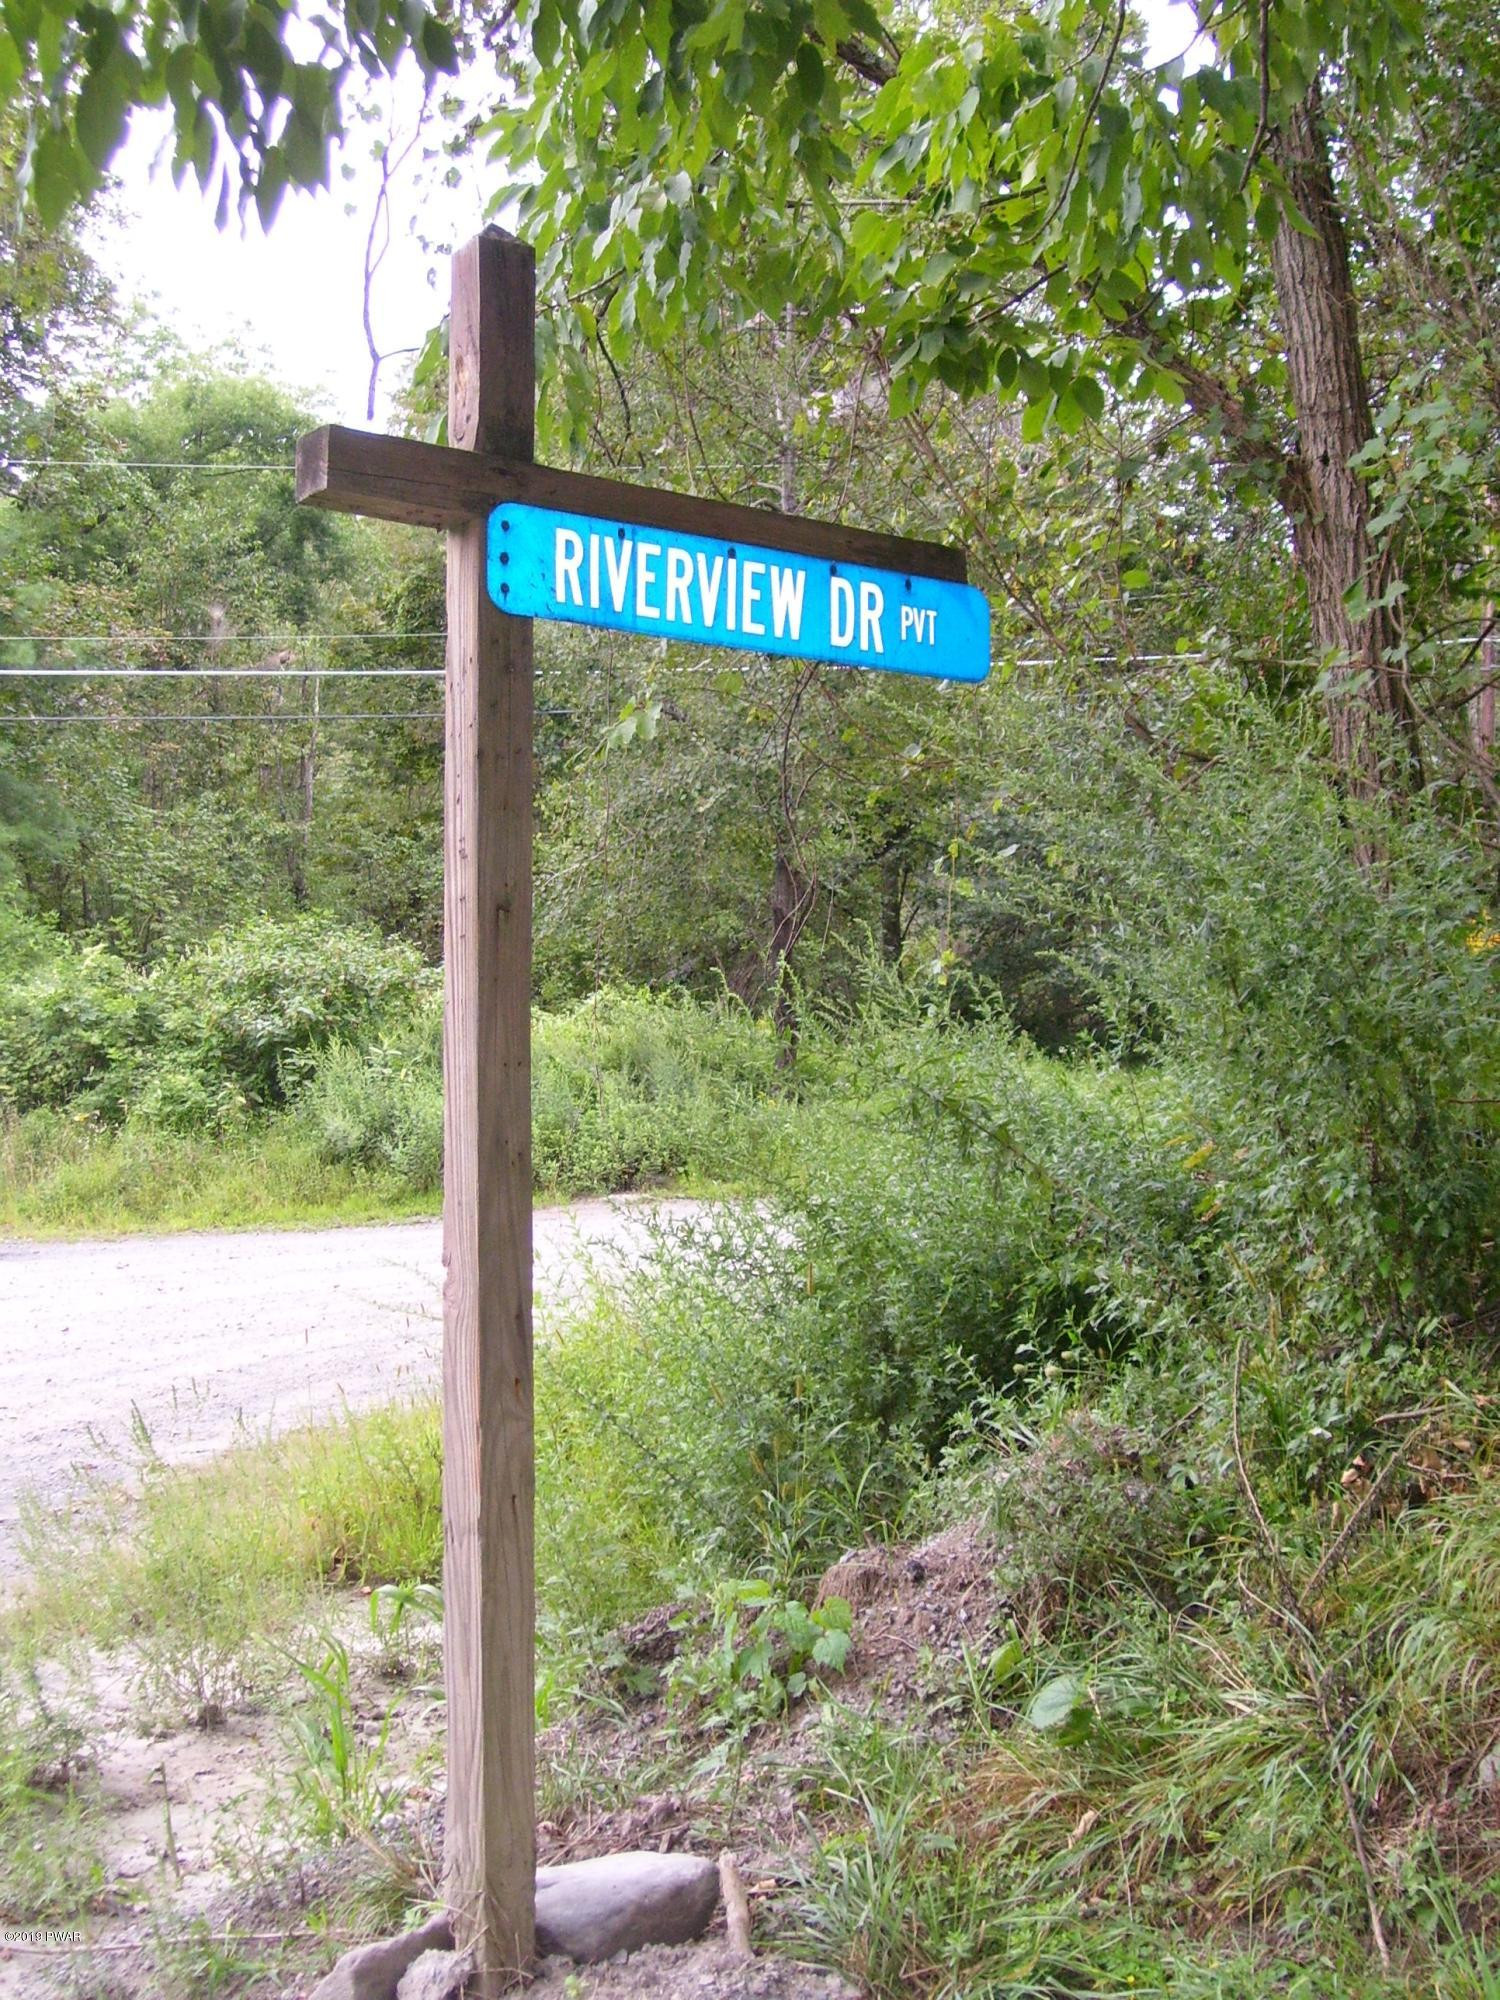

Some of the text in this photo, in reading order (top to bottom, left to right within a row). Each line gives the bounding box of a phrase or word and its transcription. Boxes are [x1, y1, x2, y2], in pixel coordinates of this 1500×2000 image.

[555, 527, 938, 653] RIVERVIEW DR PVT
